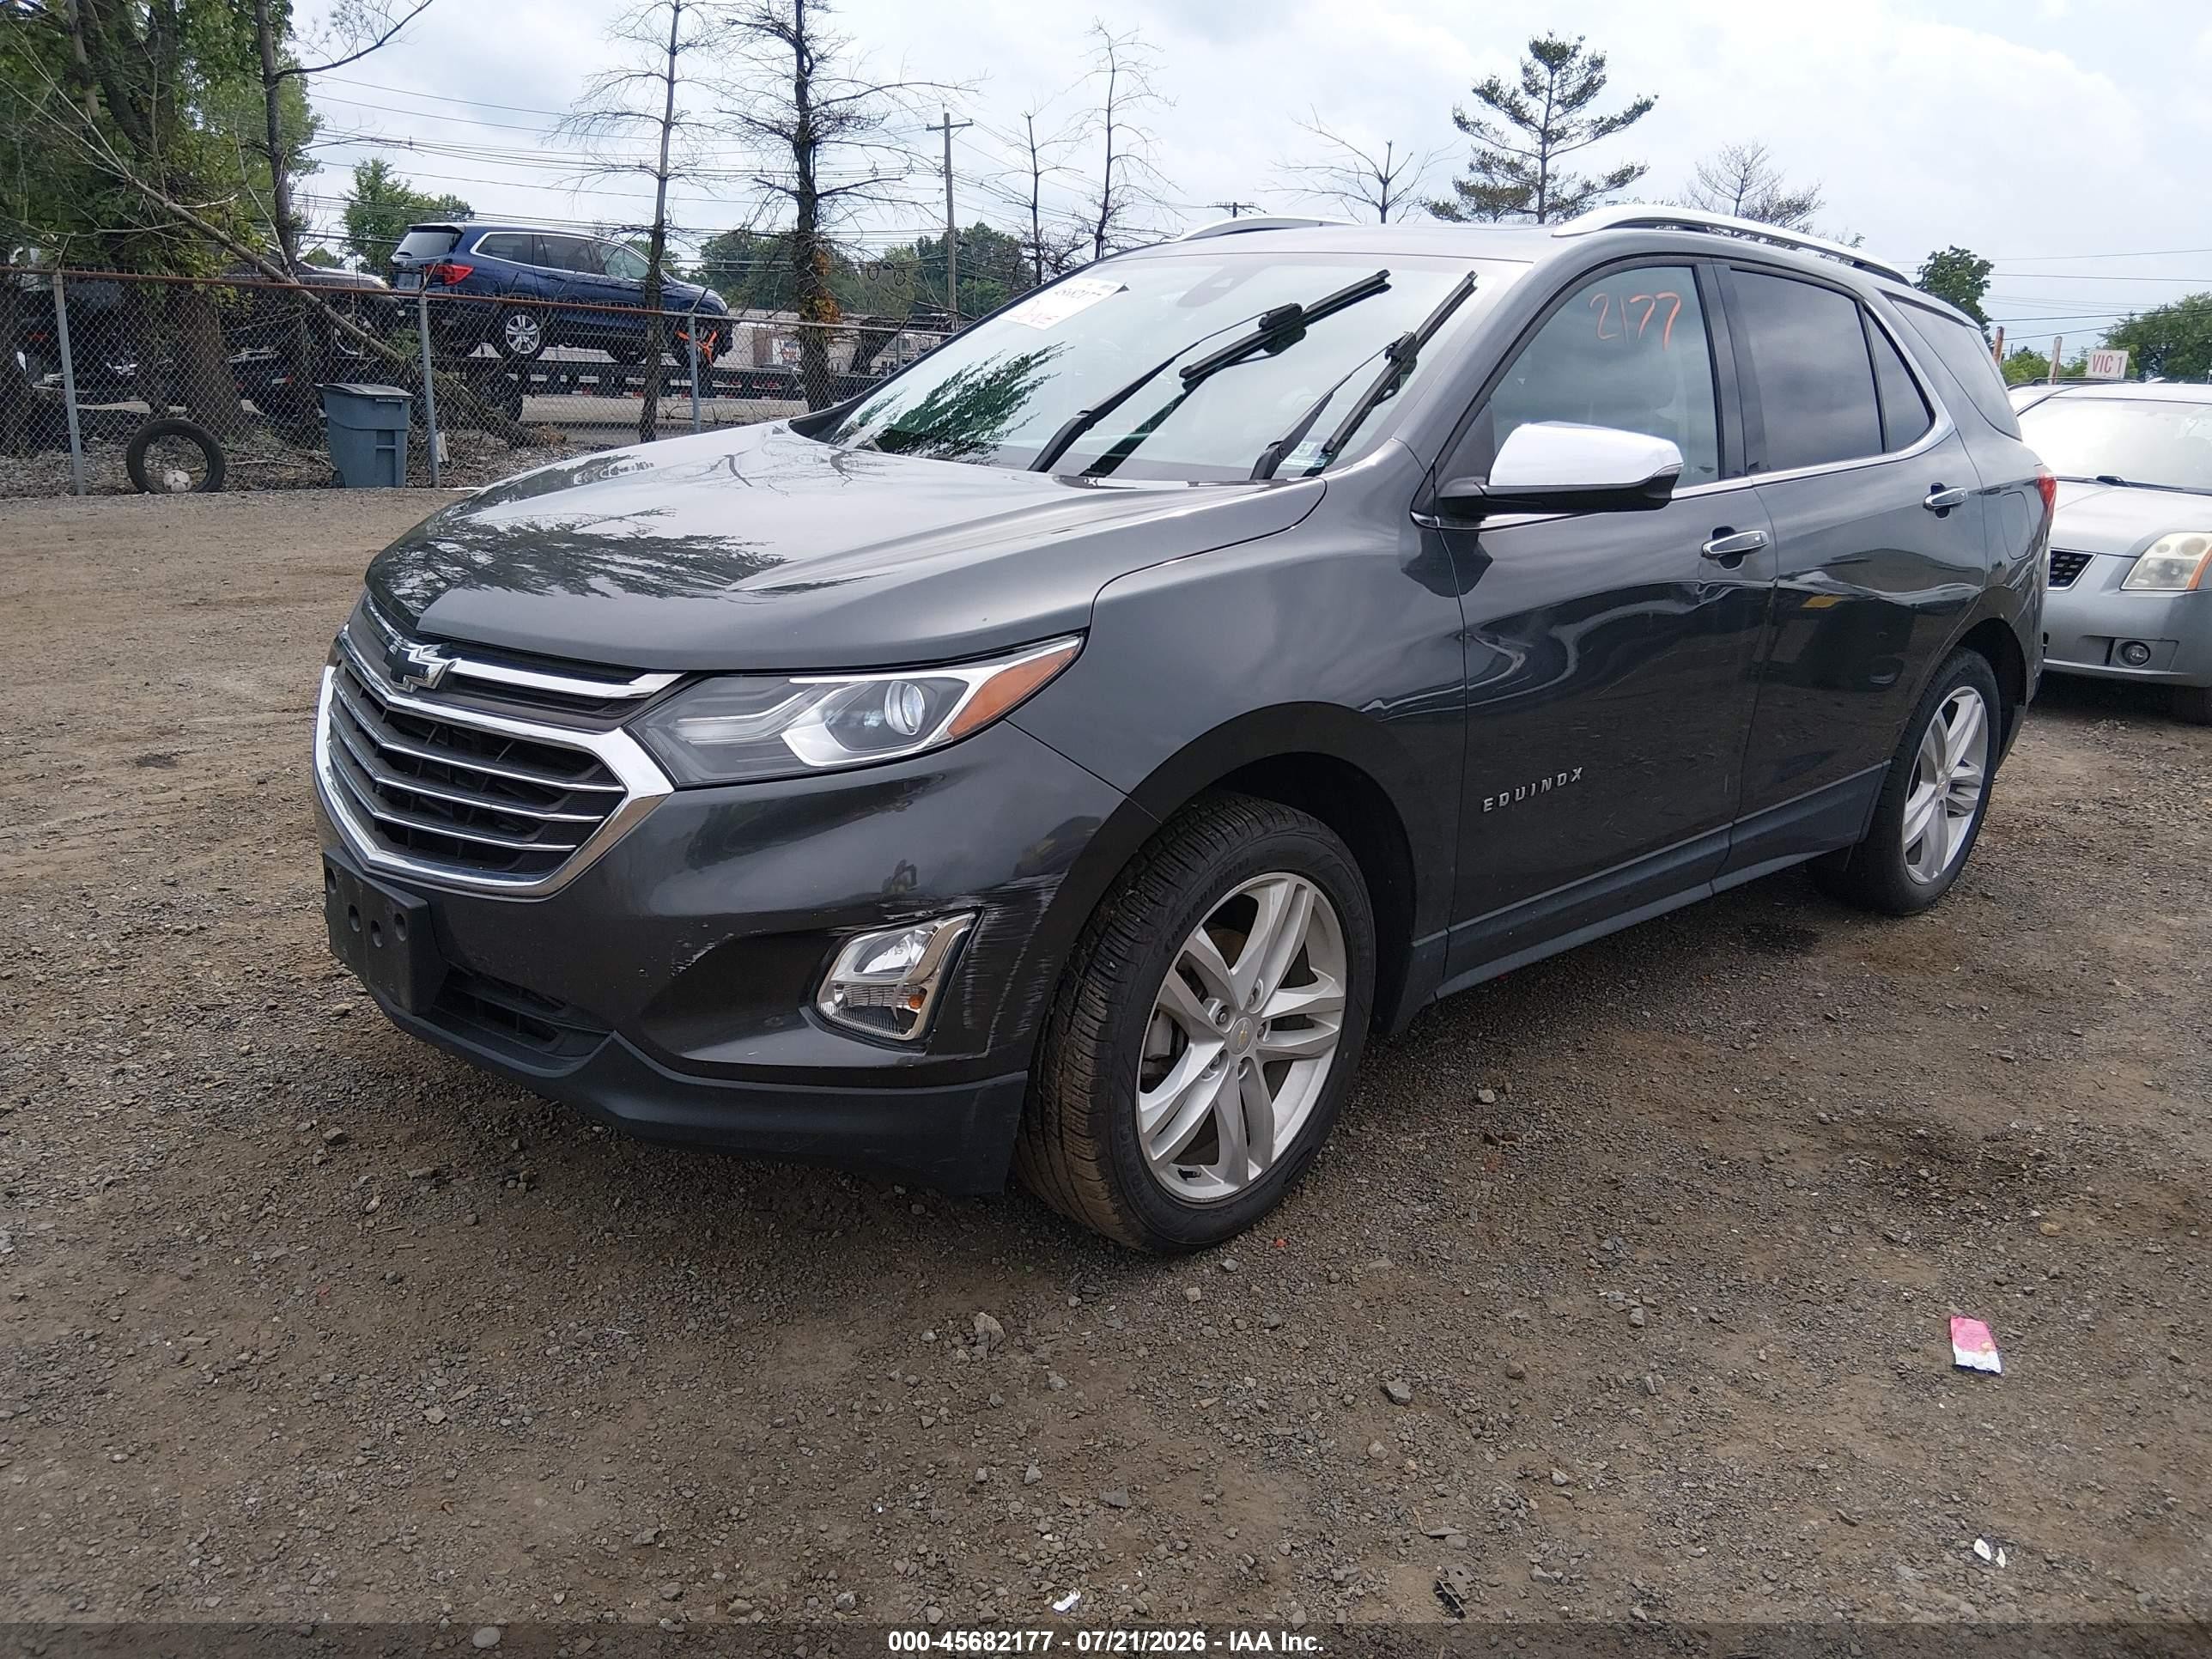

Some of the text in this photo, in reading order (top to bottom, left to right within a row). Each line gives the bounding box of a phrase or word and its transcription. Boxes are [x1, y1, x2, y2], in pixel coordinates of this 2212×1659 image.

[1589, 292, 1681, 350] 2177
[2093, 355, 2124, 374] VIC 1
[1483, 766, 1583, 812] EQUINOX
